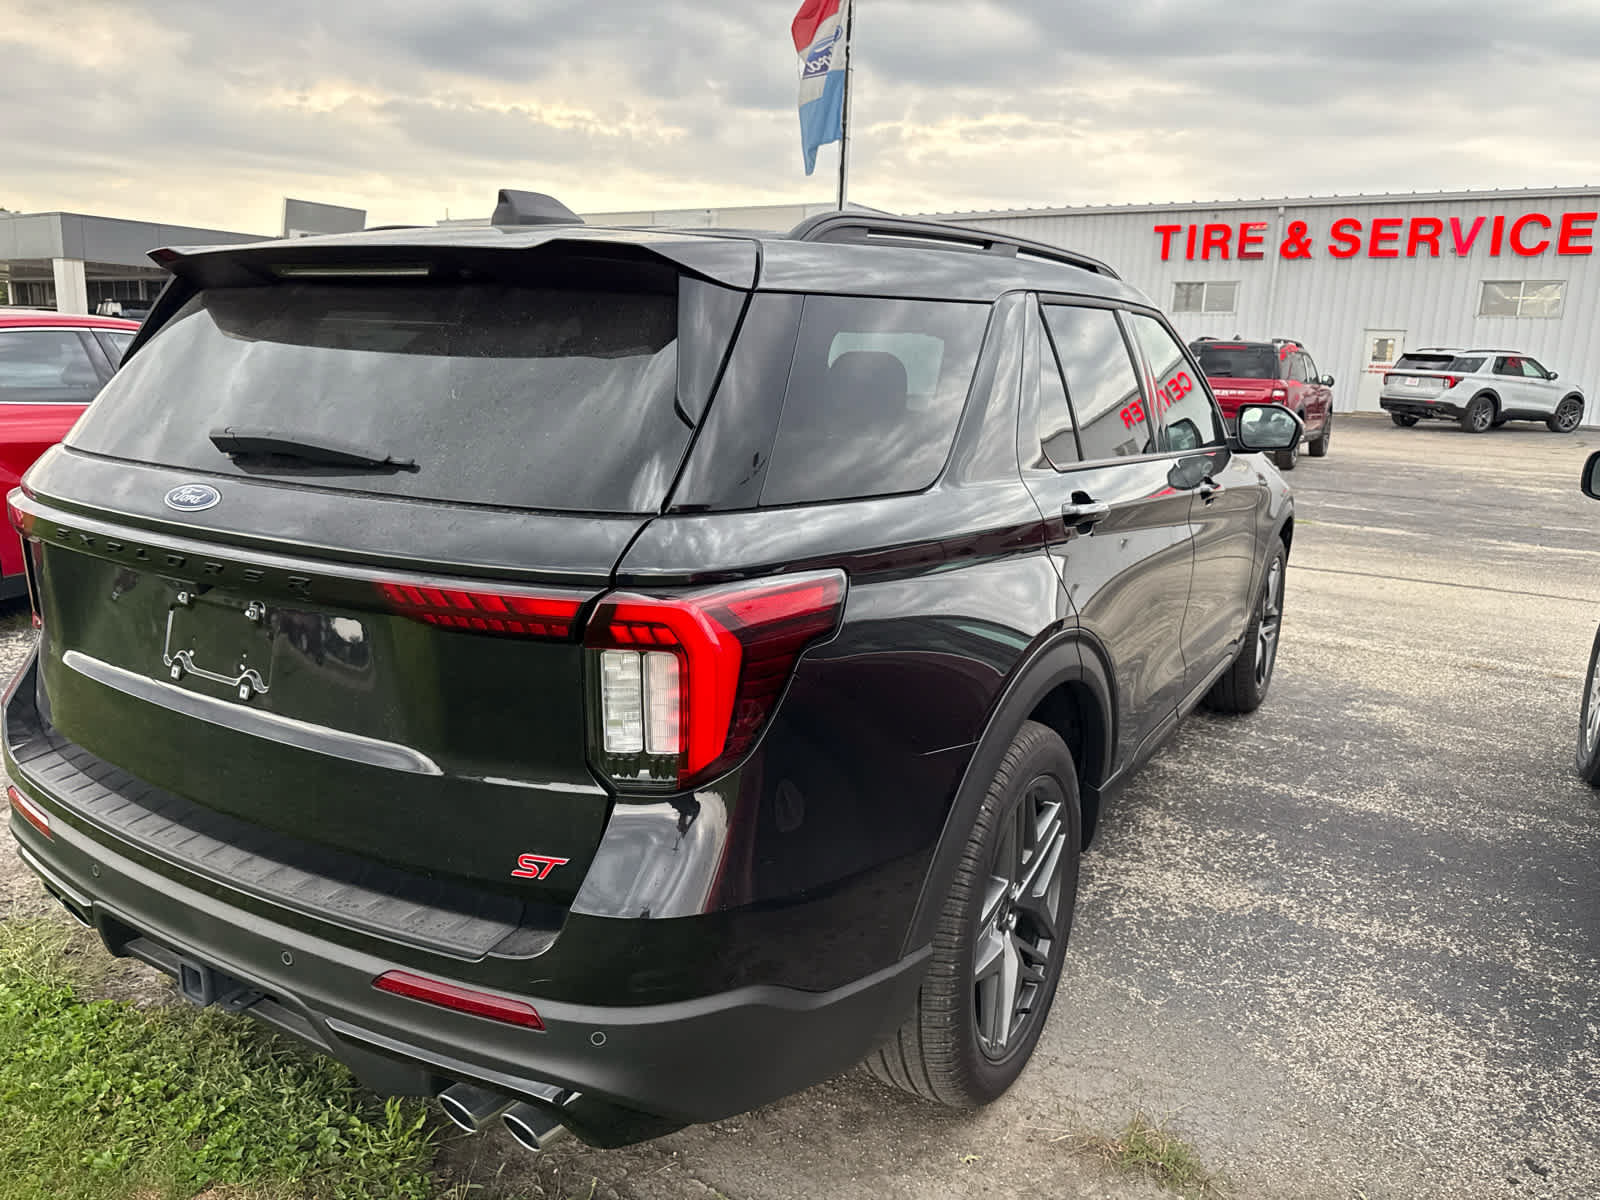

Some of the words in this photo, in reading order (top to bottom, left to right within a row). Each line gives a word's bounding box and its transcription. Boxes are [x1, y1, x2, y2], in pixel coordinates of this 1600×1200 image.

[1153, 221, 1268, 261] TIRE
[1279, 220, 1313, 260] &
[1328, 212, 1598, 258] SERVICE
[510, 853, 571, 880] ST
